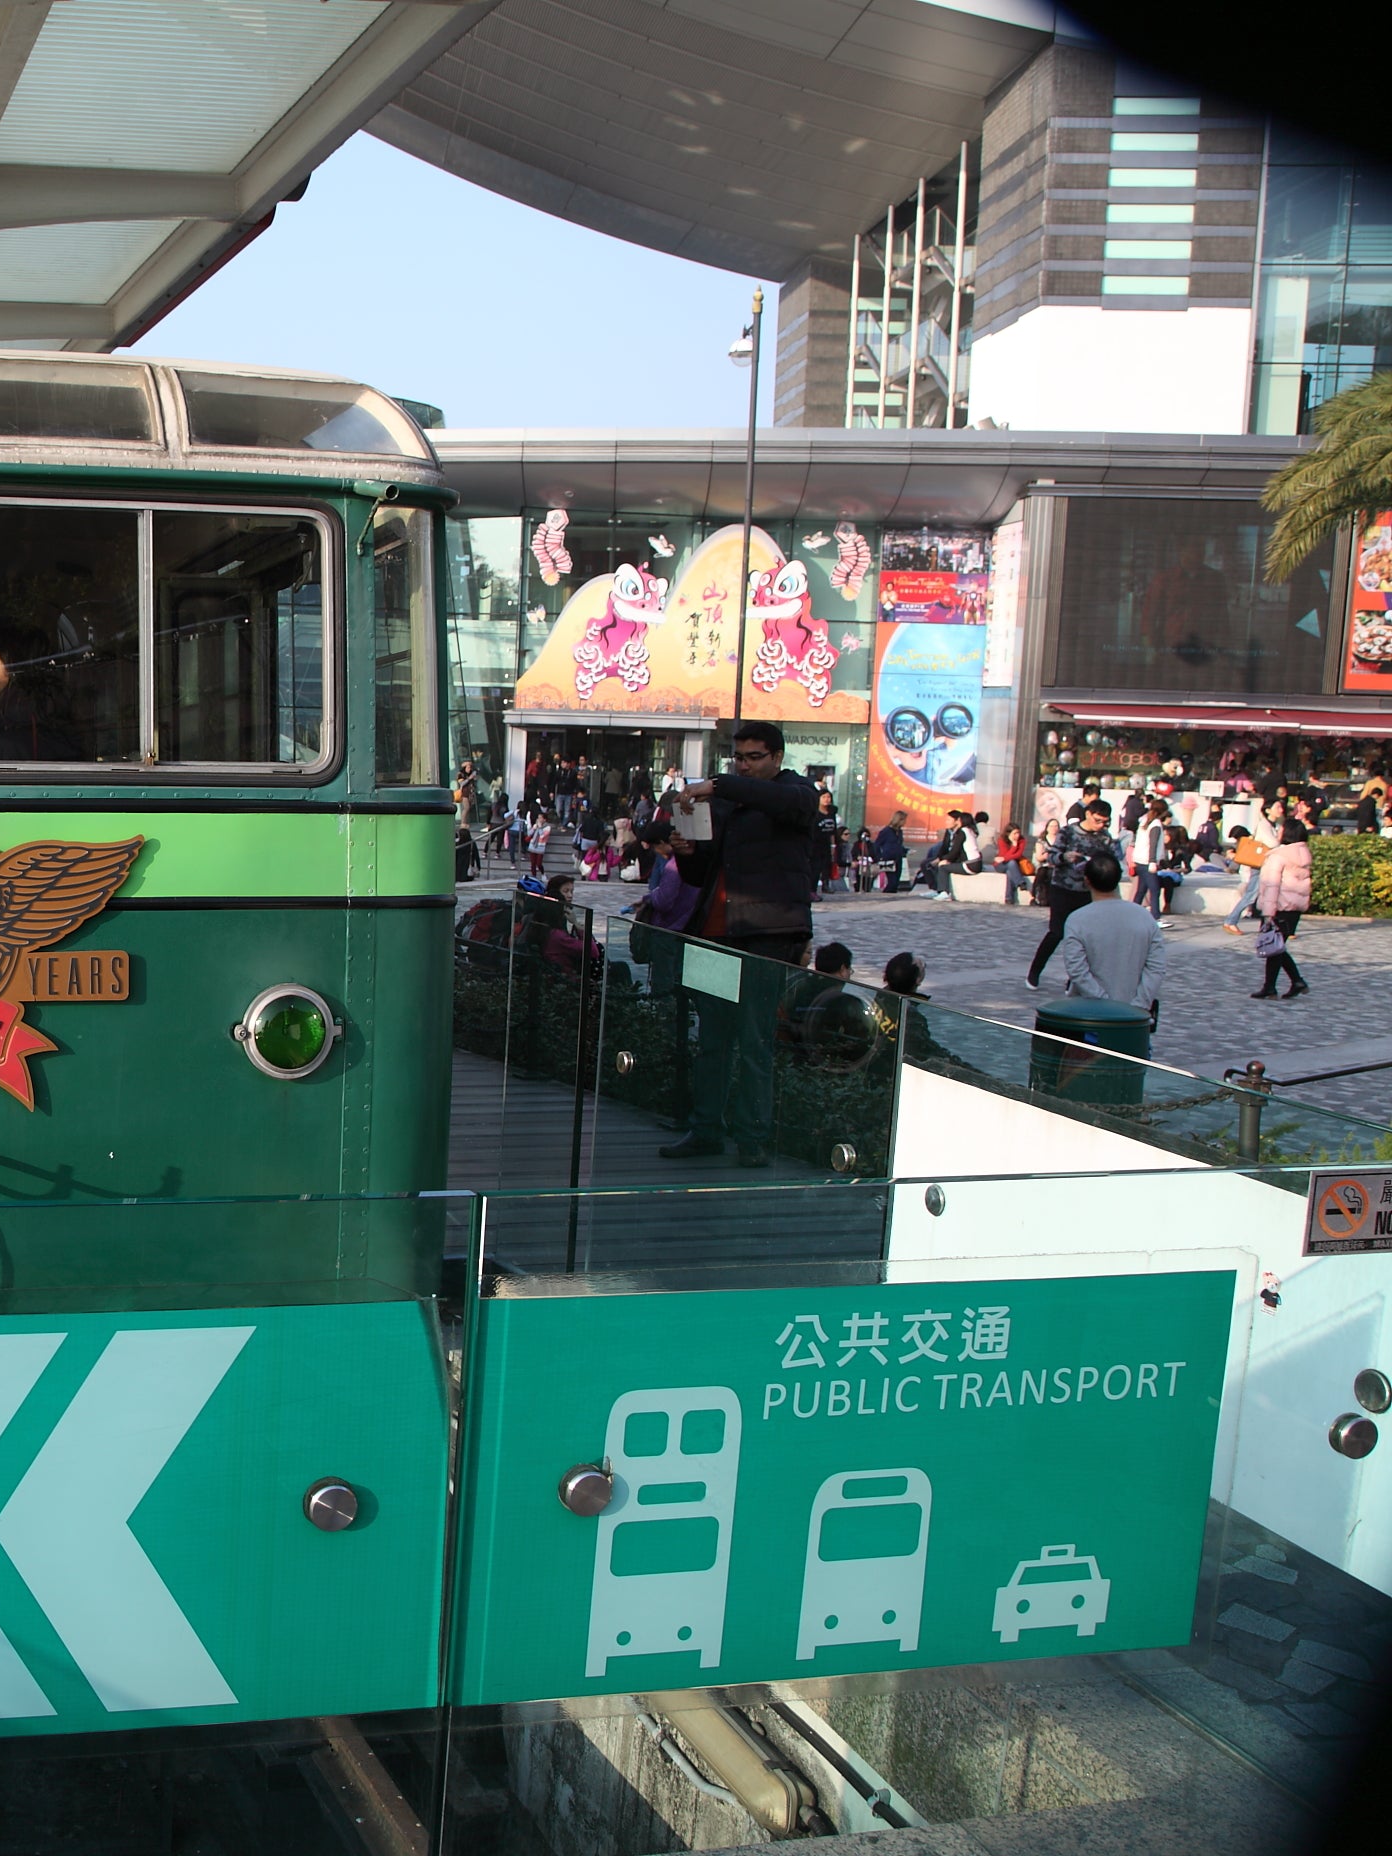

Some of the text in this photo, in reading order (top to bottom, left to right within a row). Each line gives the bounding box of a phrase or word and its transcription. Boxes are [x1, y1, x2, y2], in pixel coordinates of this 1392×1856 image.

[784, 735, 838, 746] WAROVSKI
[27, 955, 124, 995] YEARS
[774, 1305, 1011, 1369] 公共交通
[763, 1361, 1187, 1420] PUBLIC TRANSPORT
